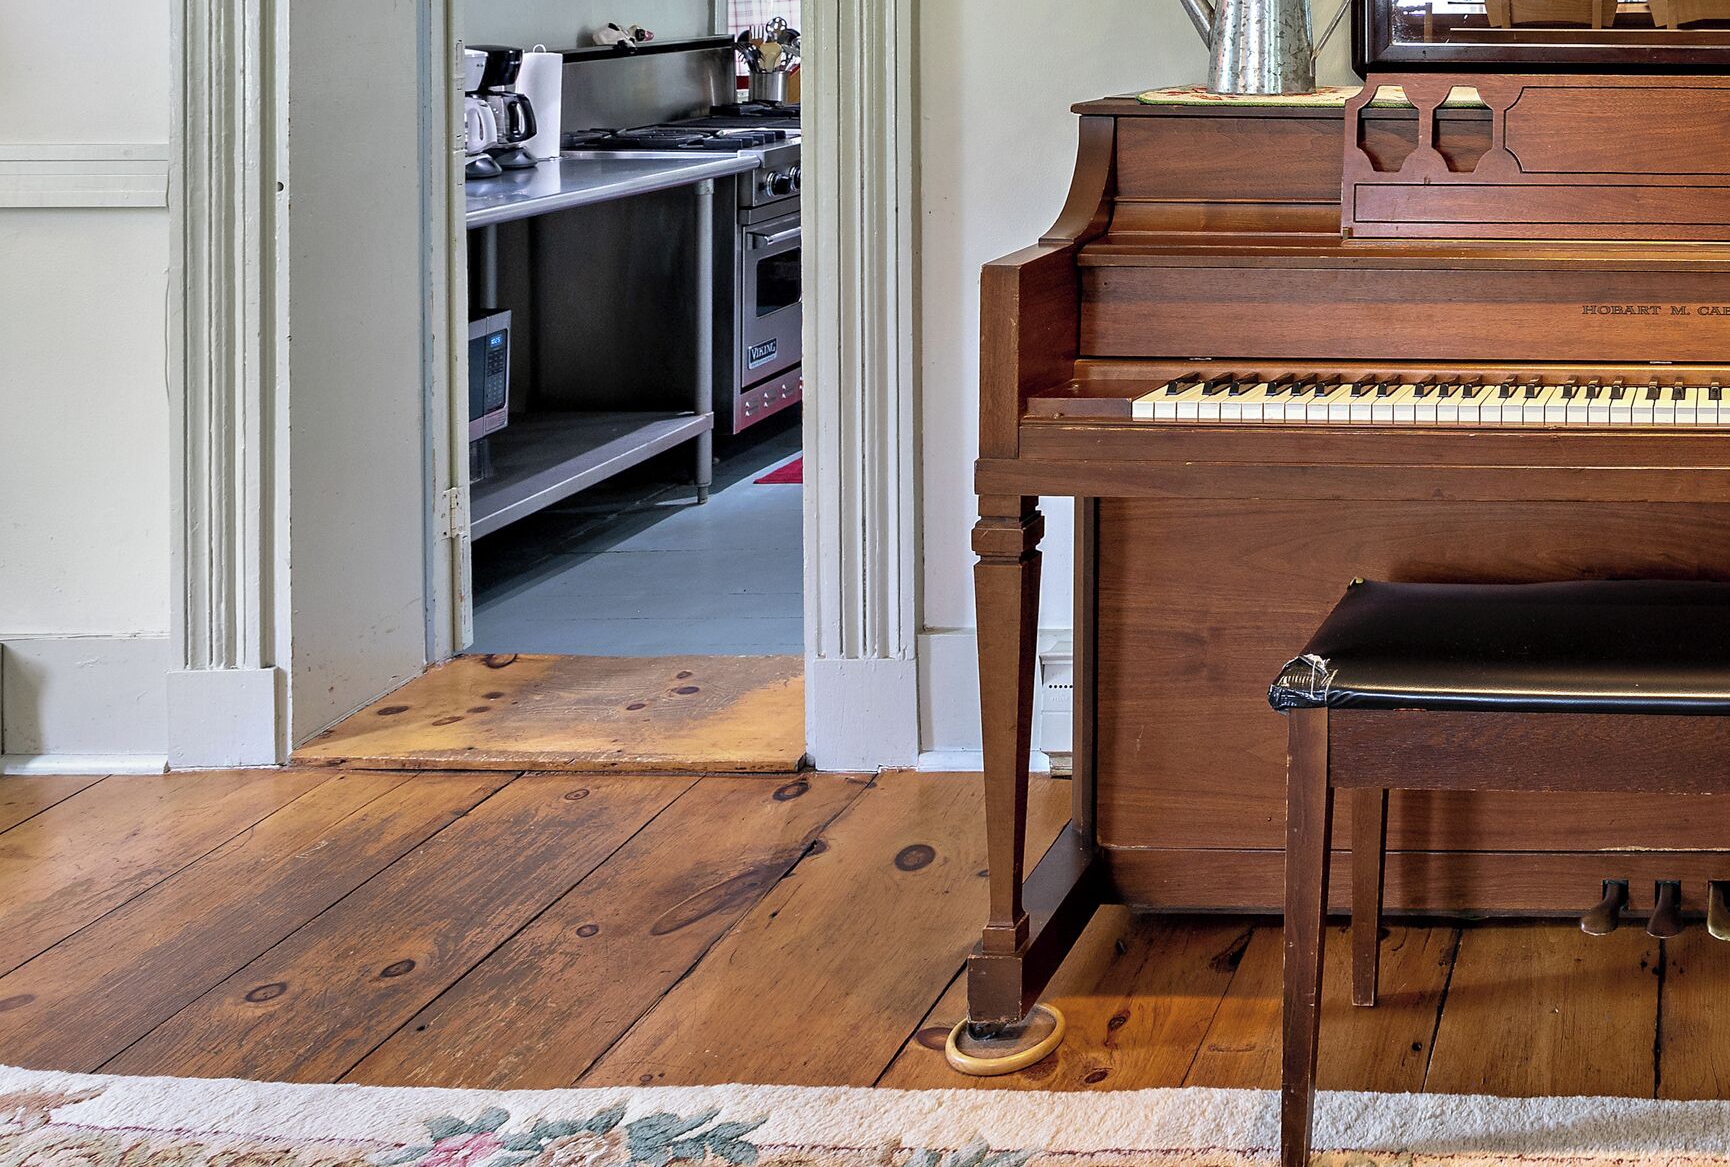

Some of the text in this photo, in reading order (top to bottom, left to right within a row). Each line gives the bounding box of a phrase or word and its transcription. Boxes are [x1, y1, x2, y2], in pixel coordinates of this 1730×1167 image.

[1582, 305, 1661, 315] HOBART
[1670, 305, 1690, 315] M.
[751, 340, 776, 360] VIKING
